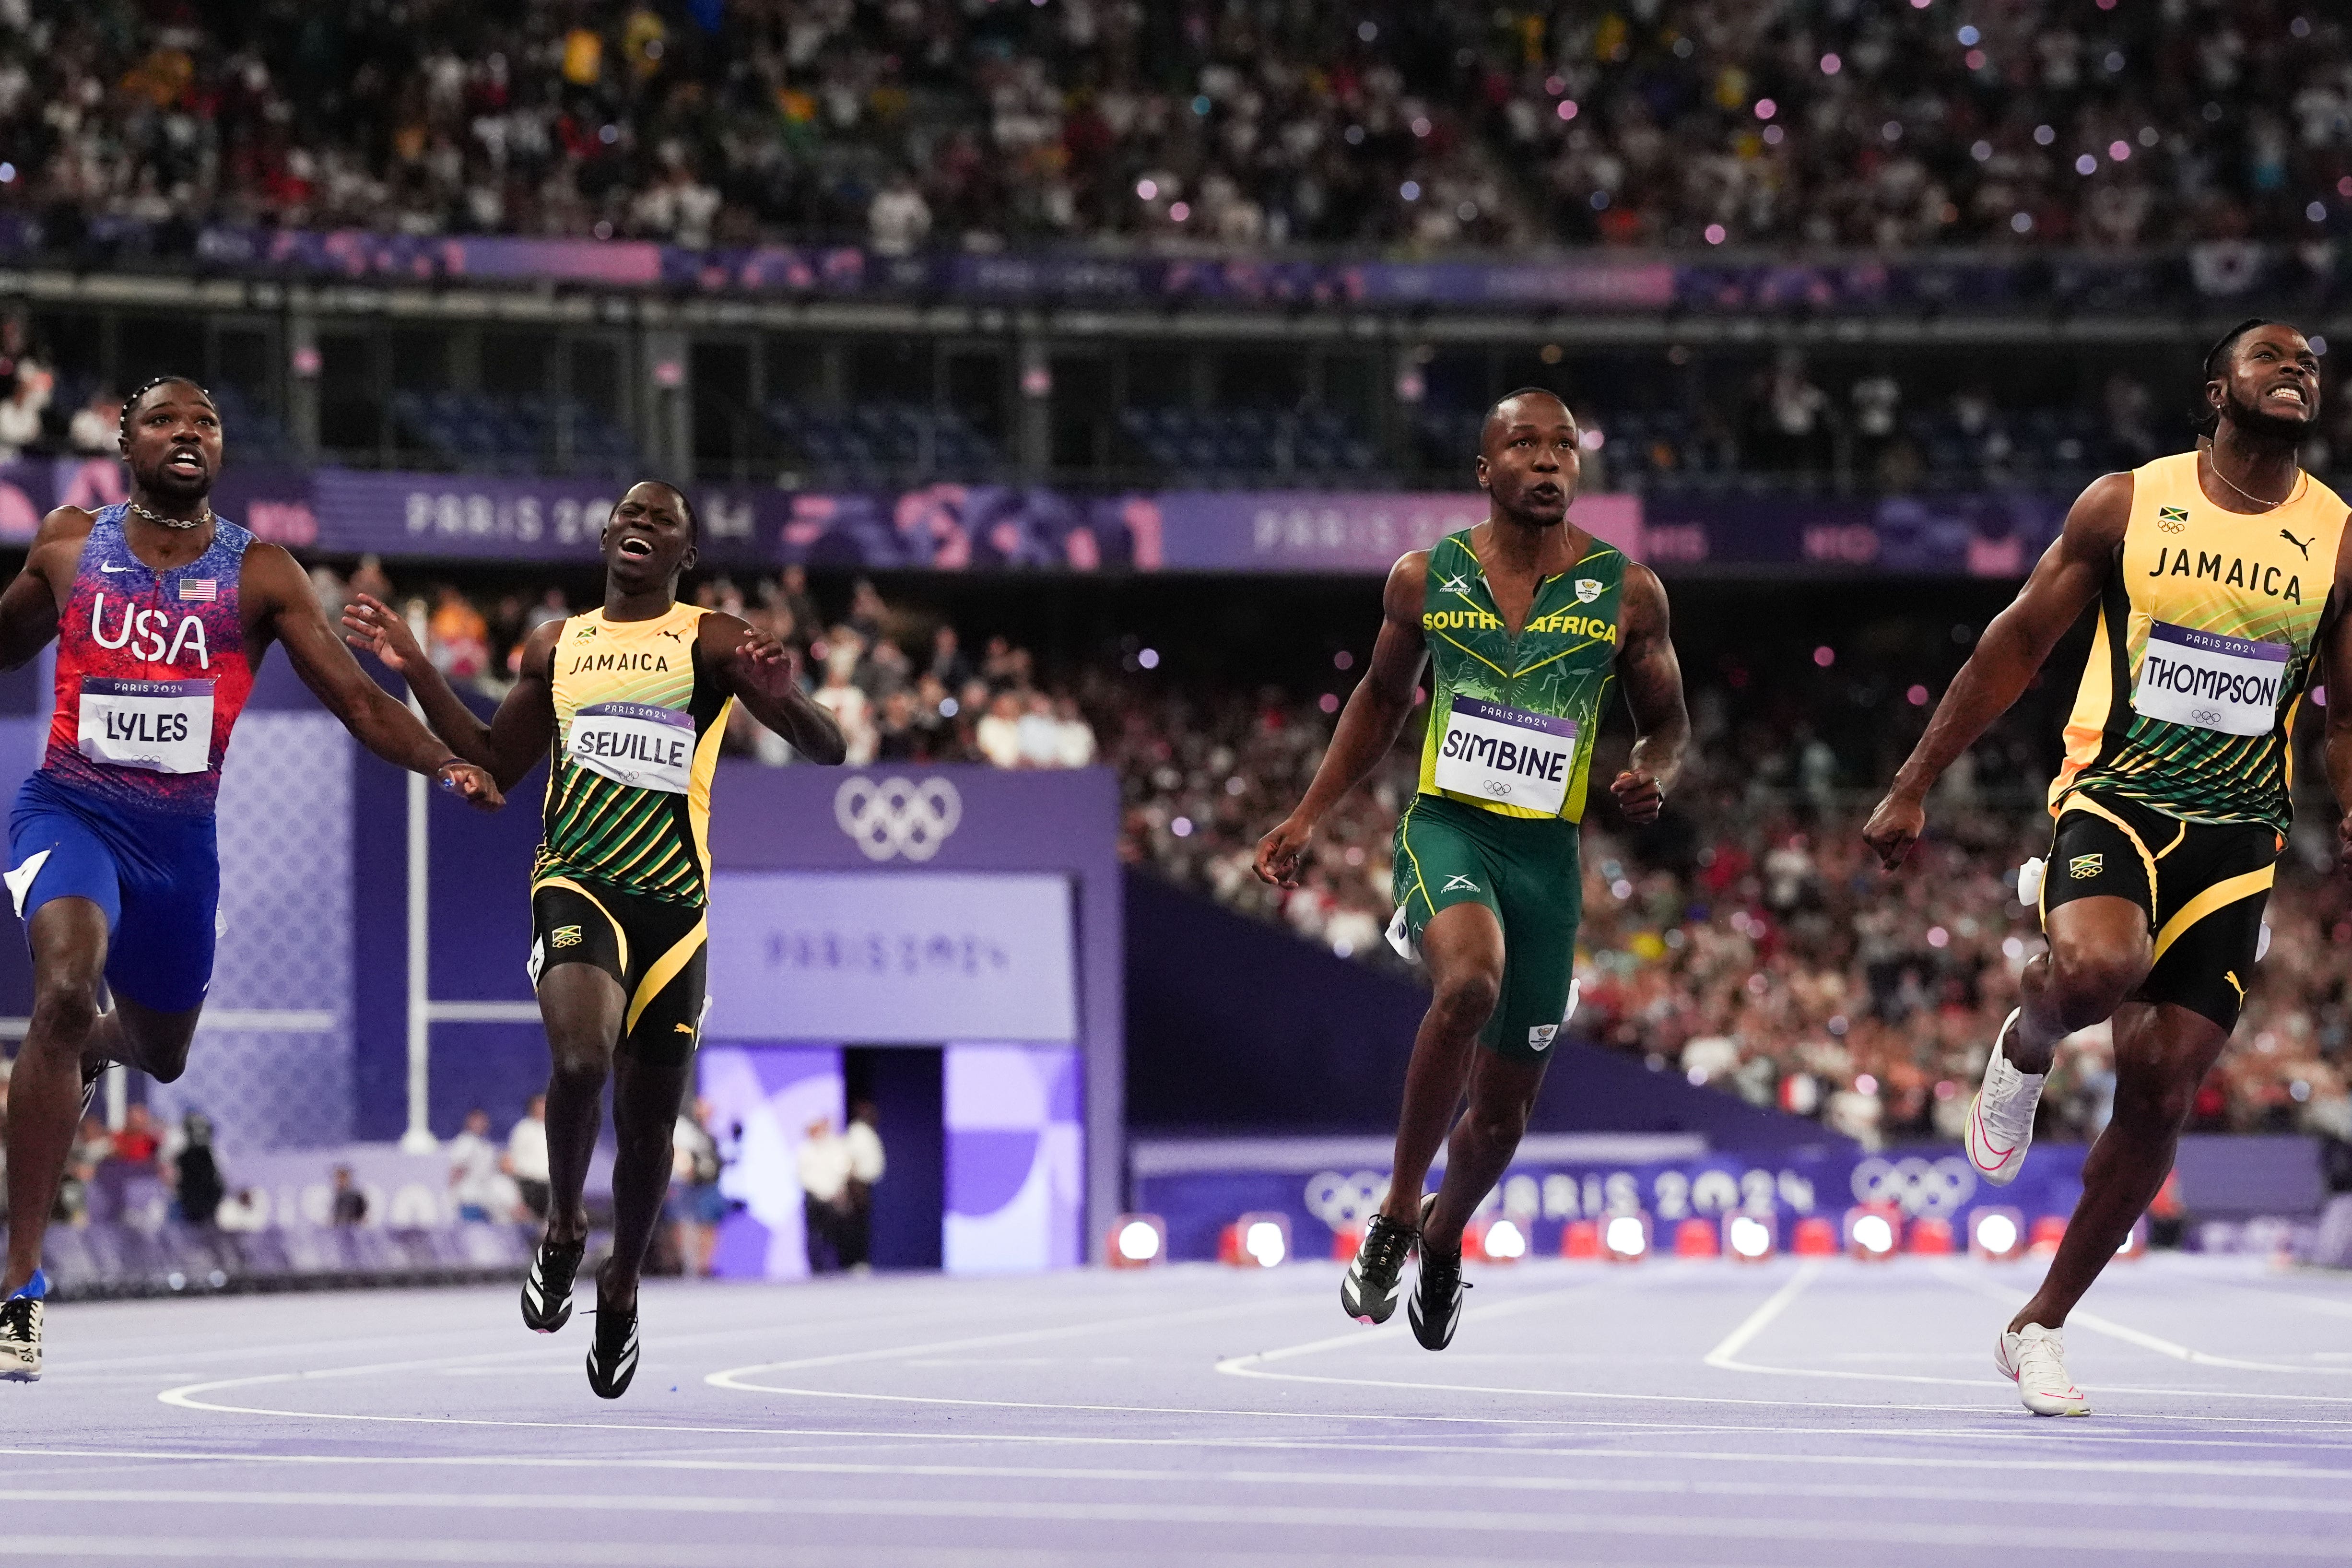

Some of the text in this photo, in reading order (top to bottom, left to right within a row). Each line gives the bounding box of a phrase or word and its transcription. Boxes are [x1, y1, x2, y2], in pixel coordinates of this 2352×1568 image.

[2149, 548, 2300, 605] JAMAICA
[92, 593, 209, 670] USA
[1423, 611, 1616, 645] SOUTH AFRICA
[2186, 634, 2256, 654] PARIS 2024
[569, 653, 668, 675] JAMAICA
[115, 683, 183, 693] PARIS 2024
[2148, 656, 2277, 706] THOMPSON
[106, 711, 188, 742] LYLES
[605, 705, 666, 719] PARIS 2024
[1481, 705, 1547, 728] PARIS 2024
[577, 731, 685, 768] SEVILLE
[1443, 730, 1567, 782] SIMBINE
